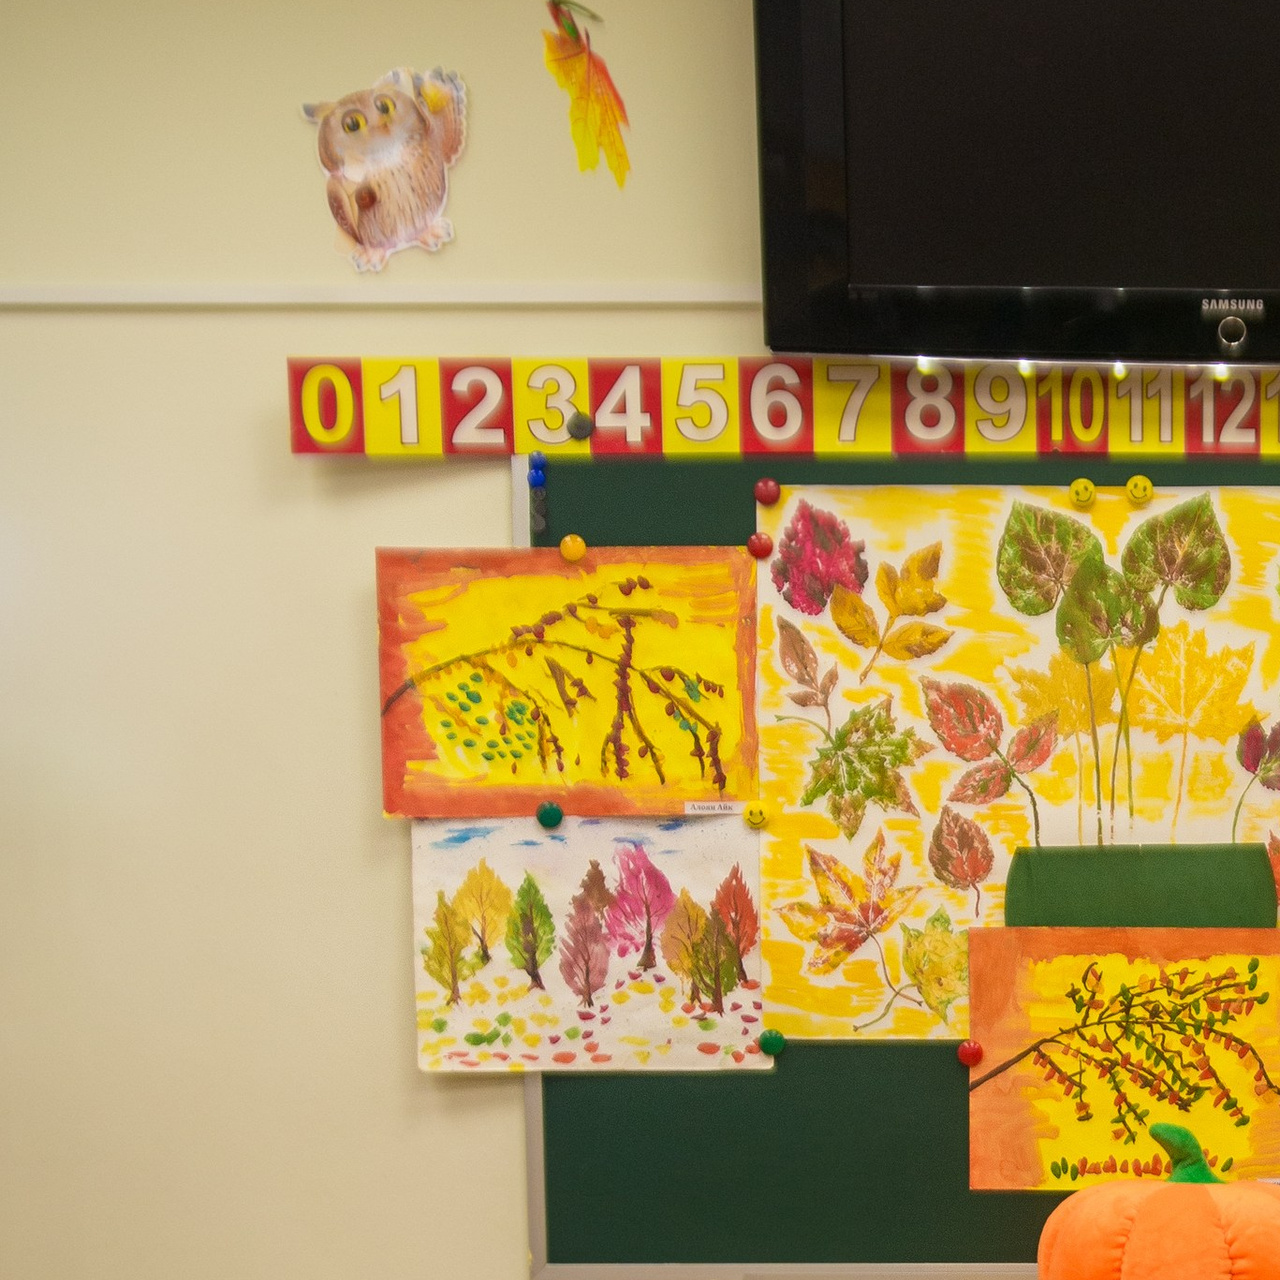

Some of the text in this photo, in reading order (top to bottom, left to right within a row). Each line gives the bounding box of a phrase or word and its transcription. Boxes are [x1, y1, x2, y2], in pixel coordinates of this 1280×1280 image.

[1202, 299, 1264, 310] SAMSUNG
[302, 363, 353, 444] 0
[380, 366, 416, 444] 1
[451, 366, 504, 444] 2
[527, 366, 579, 444] 3
[595, 366, 650, 442] 4
[676, 365, 728, 443] 5
[750, 363, 802, 441] 6
[827, 365, 881, 441] 7
[904, 364, 956, 441] 8
[975, 363, 1027, 441] 9
[1038, 369, 1104, 443] 10
[1117, 369, 1175, 443] 11
[1199, 369, 1255, 443] 12
